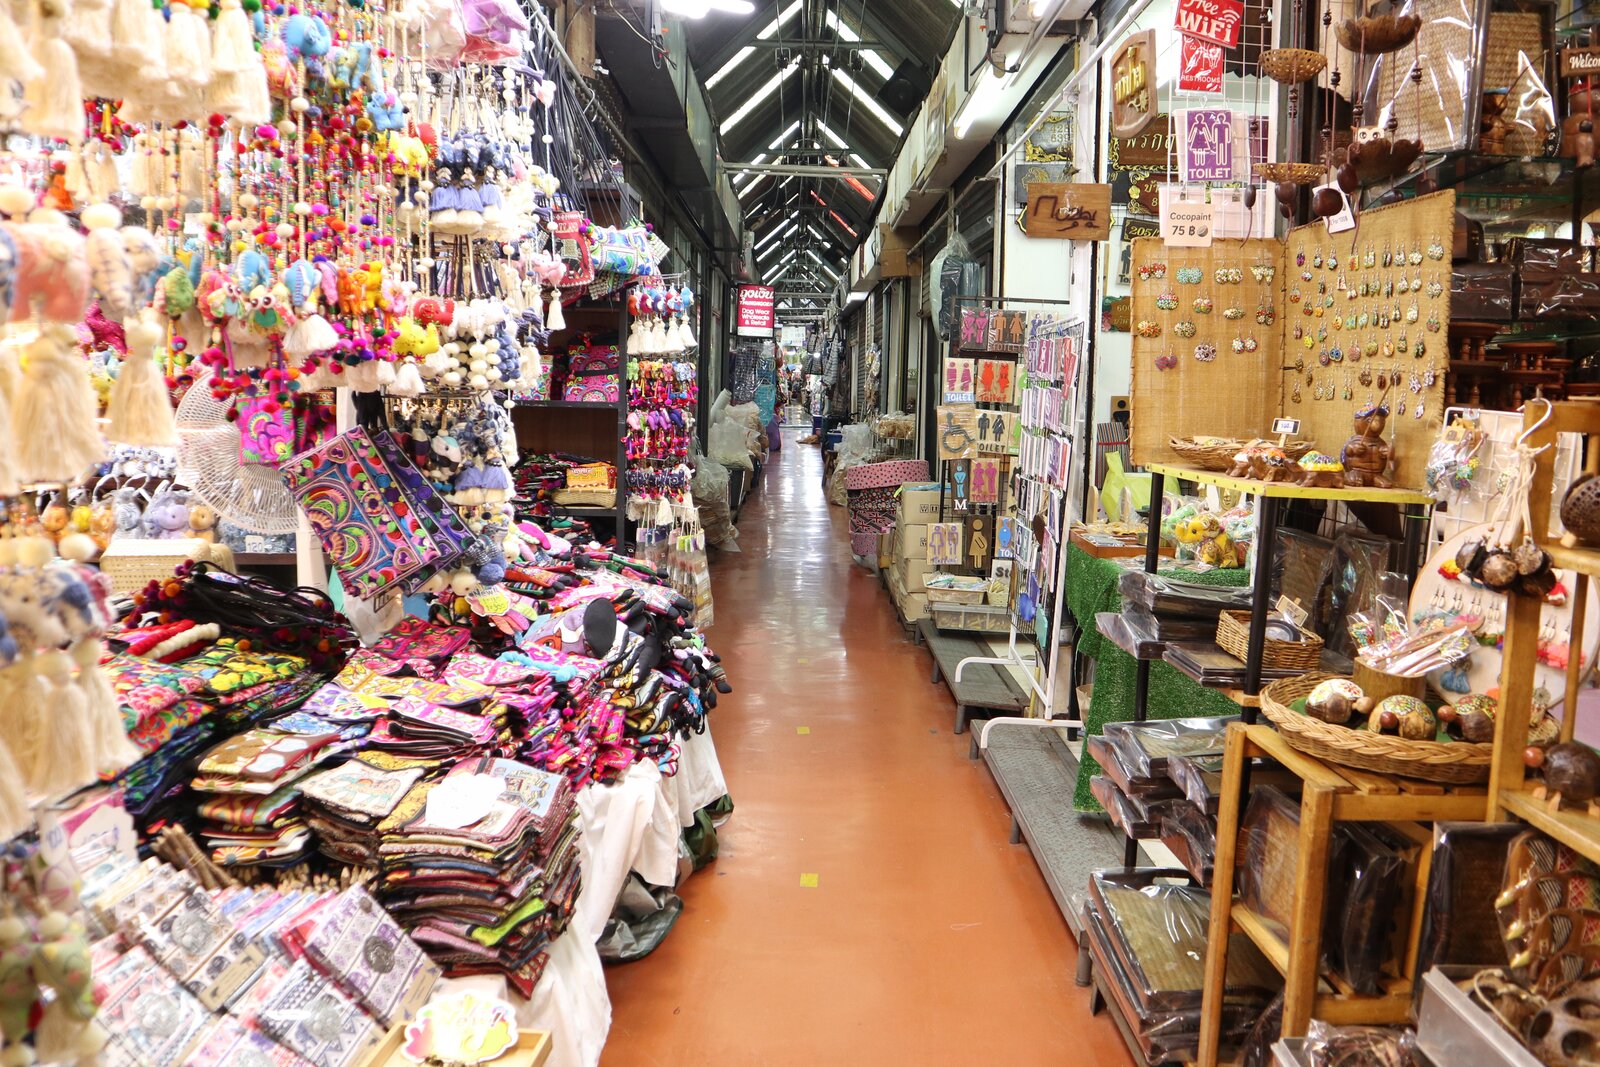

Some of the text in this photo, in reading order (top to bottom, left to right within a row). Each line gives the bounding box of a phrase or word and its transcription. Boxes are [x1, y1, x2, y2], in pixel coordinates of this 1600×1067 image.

[1180, 9, 1232, 42] WiFi
[1181, 74, 1221, 84] RESTROOMS
[1189, 168, 1231, 179] TOILET
[1170, 212, 1211, 222] Cocopaint
[1172, 225, 1185, 235] 75
[977, 443, 1006, 453] OILET
[954, 499, 967, 510] M
